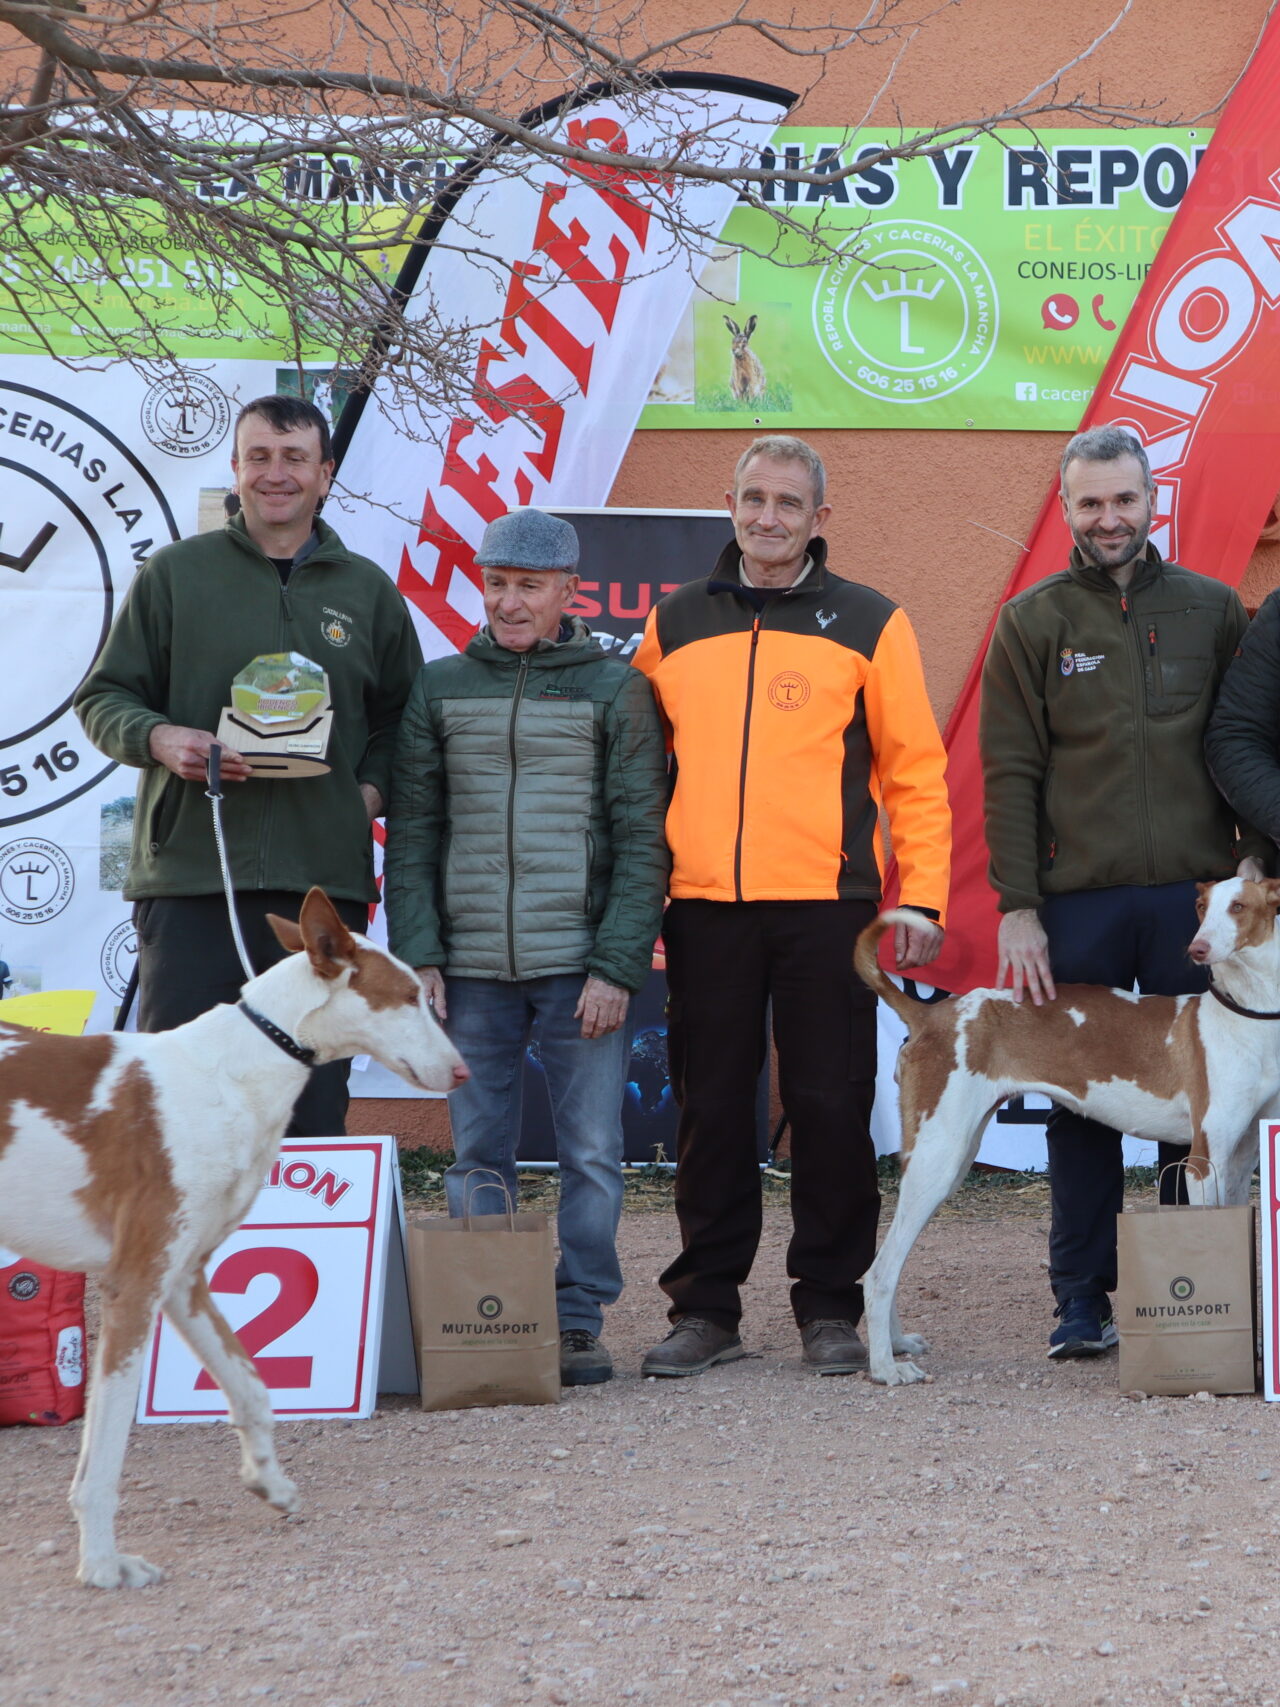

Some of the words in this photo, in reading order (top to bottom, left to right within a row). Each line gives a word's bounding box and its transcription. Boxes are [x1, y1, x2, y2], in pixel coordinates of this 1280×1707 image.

[284, 156, 472, 203] MANCH
[927, 150, 973, 205] Y
[873, 232, 884, 244] Y
[888, 229, 965, 262] CACERIAS
[1025, 224, 1062, 251] EL
[961, 261, 979, 282] LA
[969, 284, 989, 355] MANCHA
[856, 366, 891, 389] 606
[892, 378, 915, 393] 25
[918, 374, 938, 391] 15
[938, 366, 959, 383] 16
[102, 482, 144, 534] LA
[32, 741, 80, 782] 16
[269, 1159, 351, 1208] ION
[193, 1246, 319, 1391] 2
[442, 1323, 539, 1335] MUTUASPORT
[1135, 1303, 1231, 1318] MUTUASPORT
